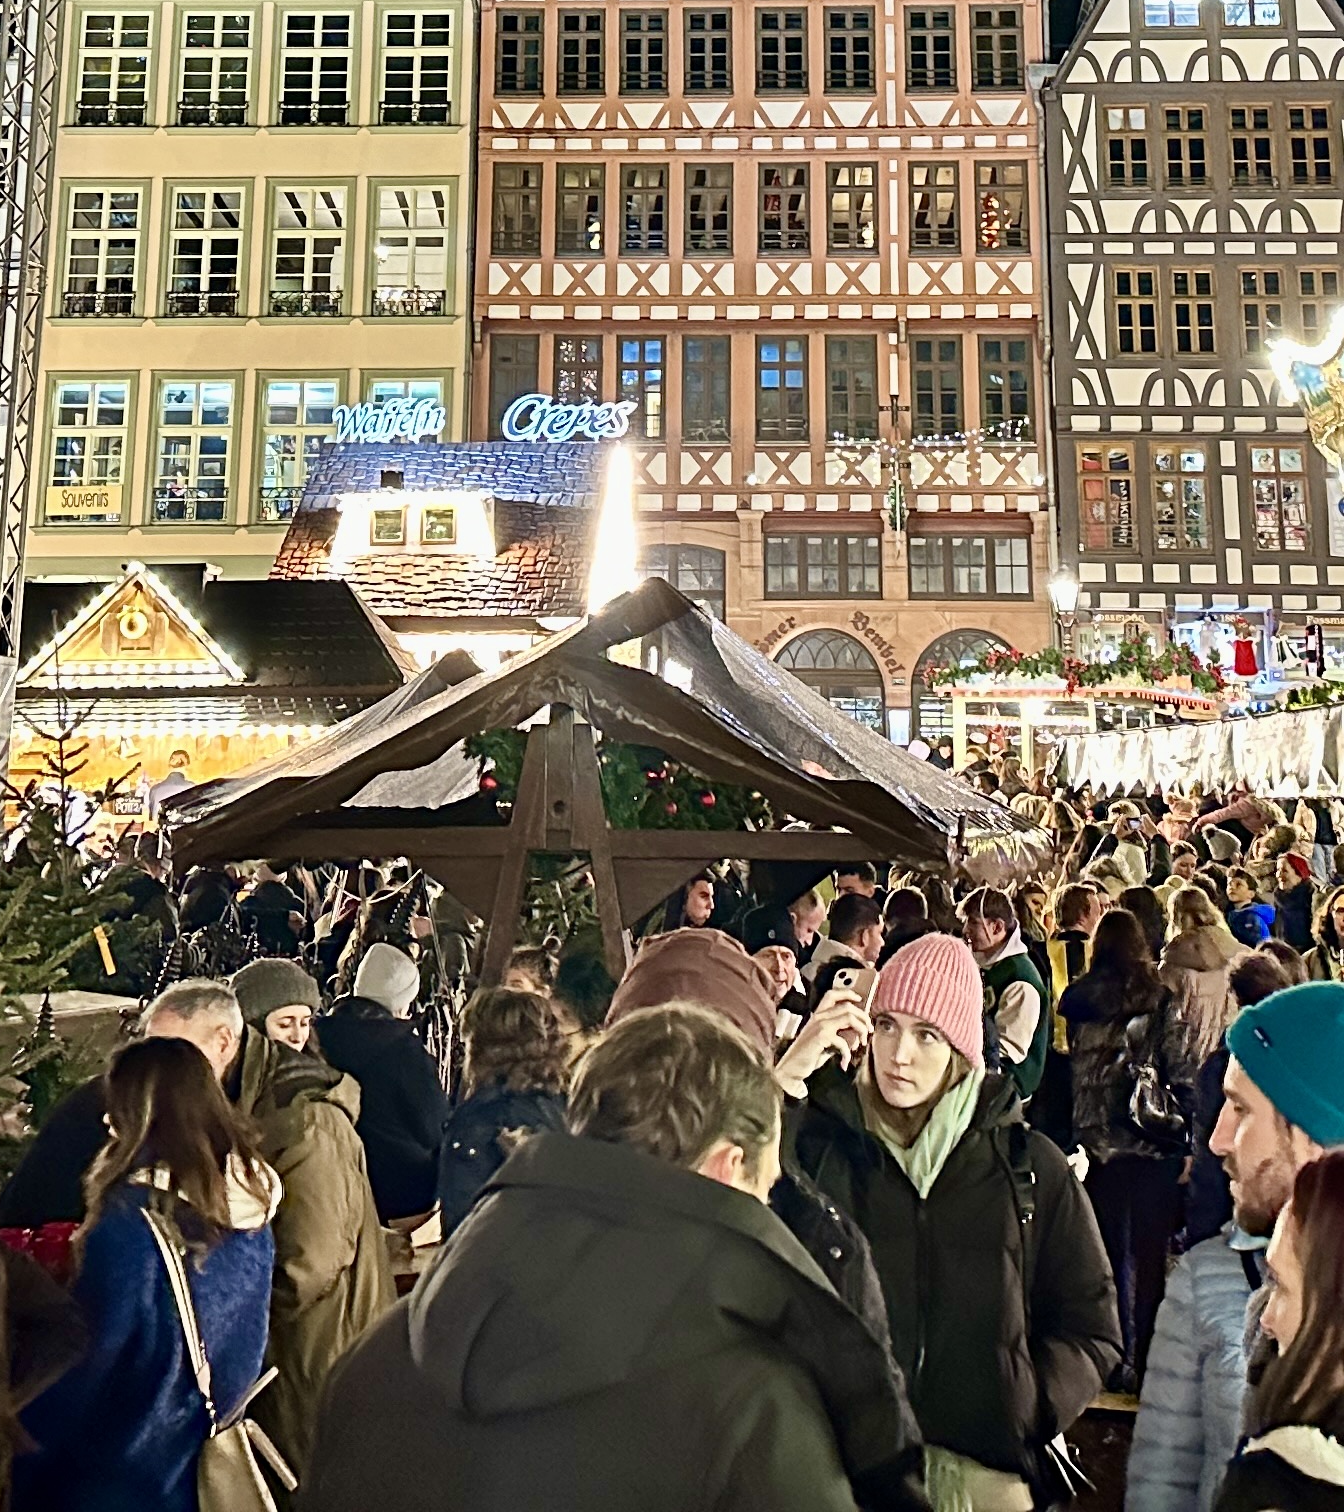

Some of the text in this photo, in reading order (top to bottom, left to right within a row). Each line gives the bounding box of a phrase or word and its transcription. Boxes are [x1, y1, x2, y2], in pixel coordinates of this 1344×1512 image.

[332, 397, 446, 443] Waffeln
[61, 489, 109, 508] Souvenirs
[849, 610, 905, 675] Bembel
